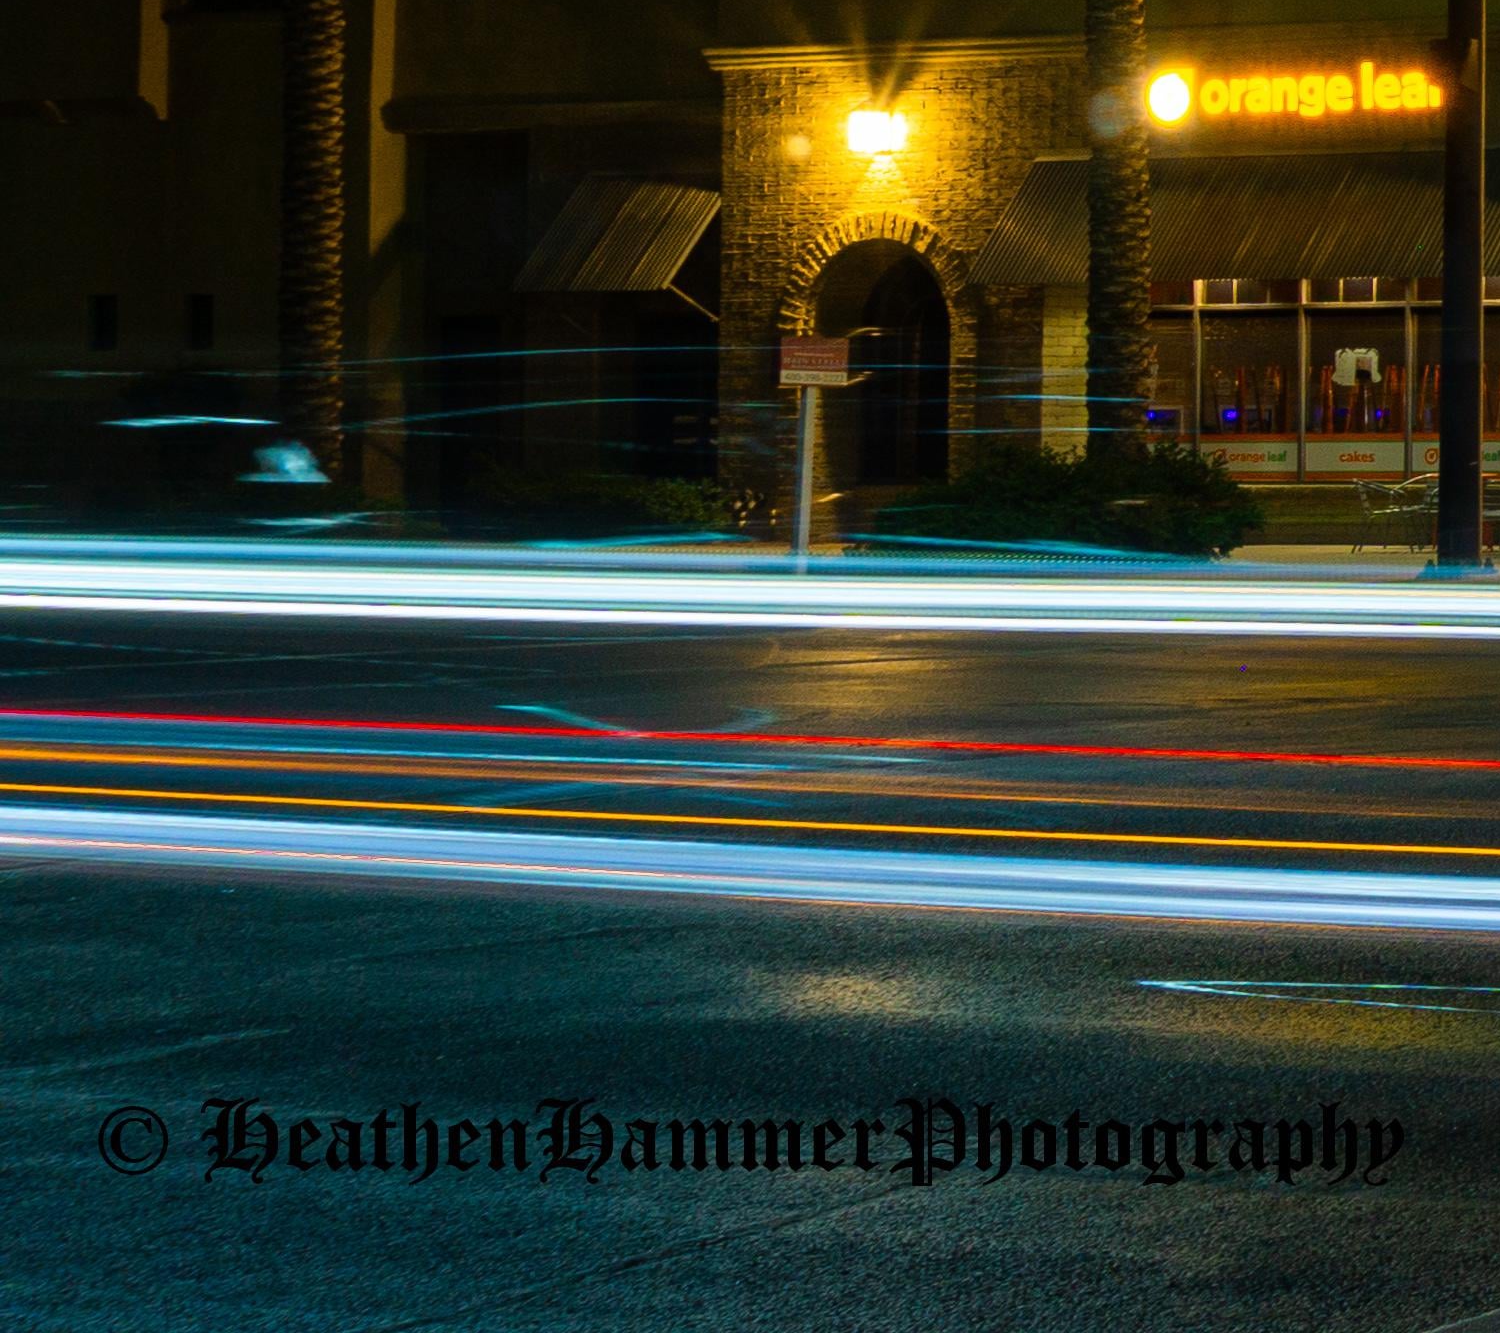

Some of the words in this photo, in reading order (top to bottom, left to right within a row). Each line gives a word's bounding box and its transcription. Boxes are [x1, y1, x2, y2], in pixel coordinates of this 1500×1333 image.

[1200, 72, 1354, 117] orange
[1228, 452, 1265, 463] orange
[1267, 450, 1287, 462] leaf
[1339, 450, 1375, 463] cakes
